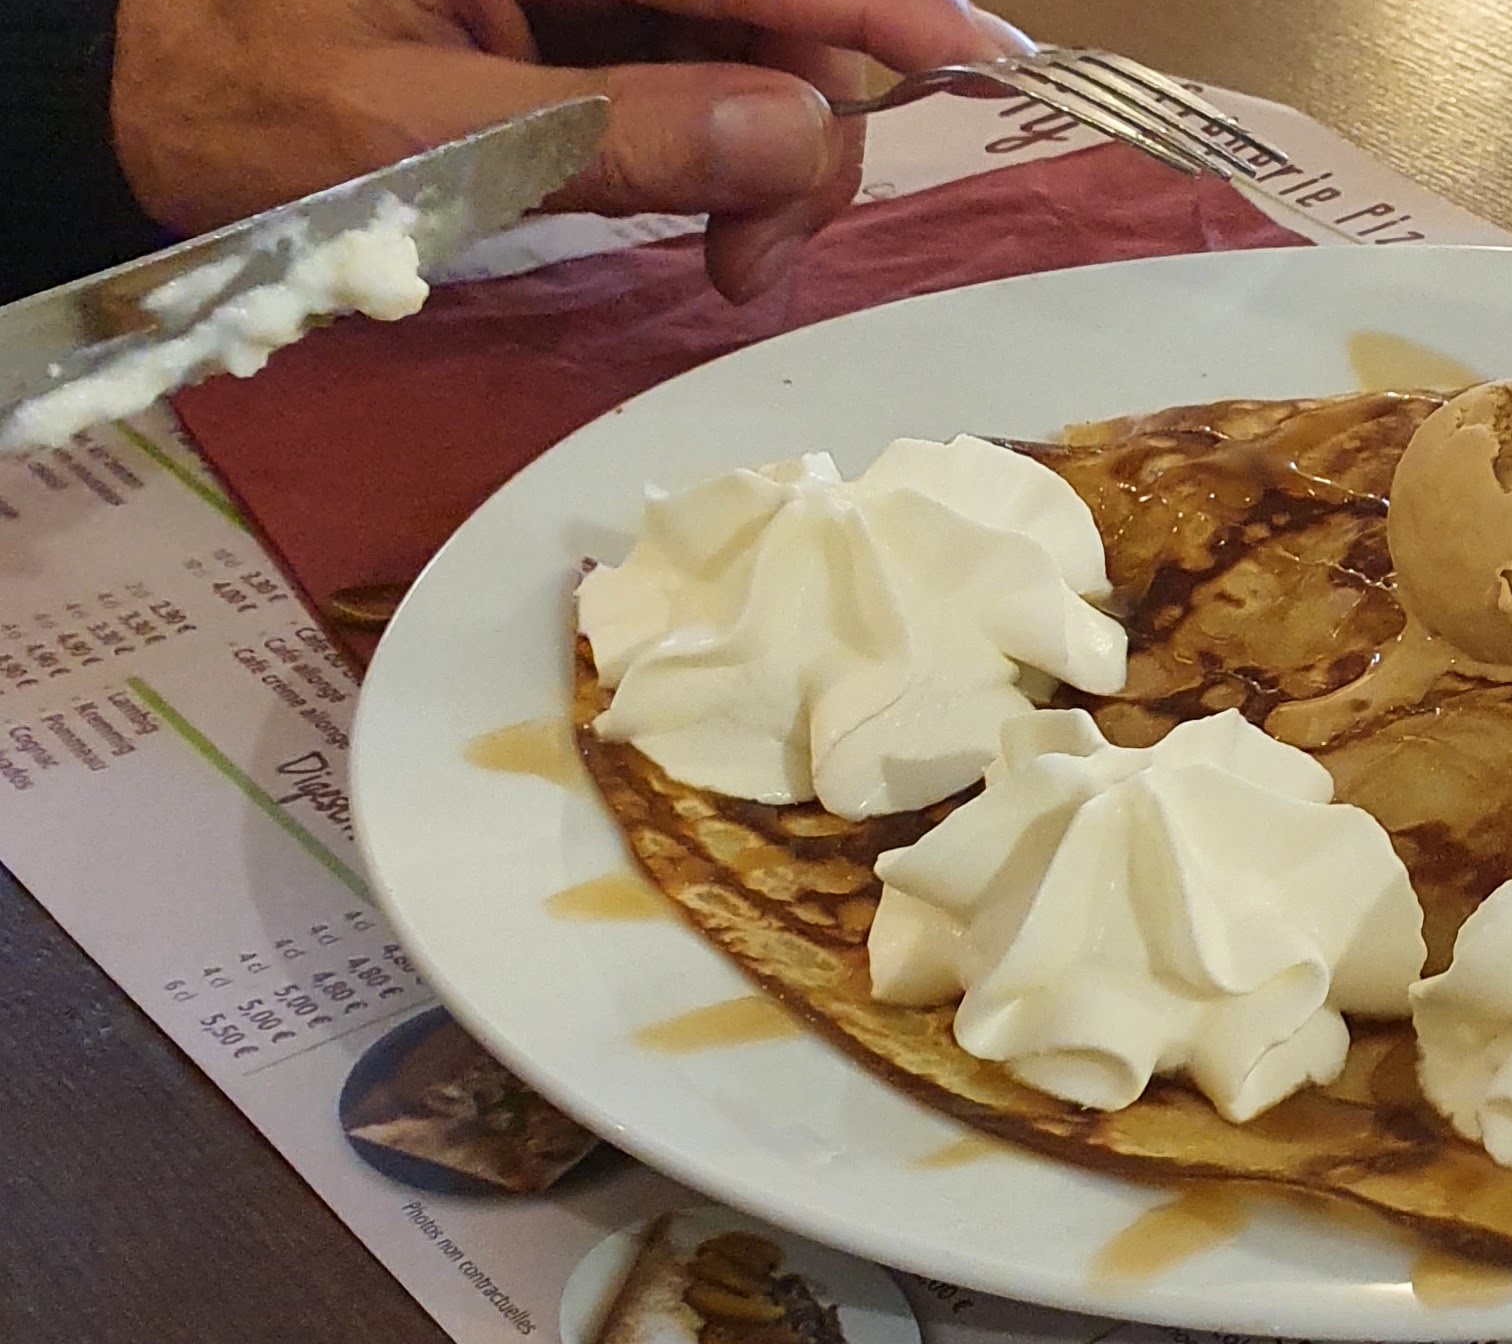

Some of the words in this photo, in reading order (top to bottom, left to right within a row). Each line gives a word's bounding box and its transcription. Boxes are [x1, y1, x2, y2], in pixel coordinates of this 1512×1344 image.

[401, 1202, 444, 1240] Photos
[436, 1238, 465, 1262] non
[458, 1260, 537, 1336] contractuelles
